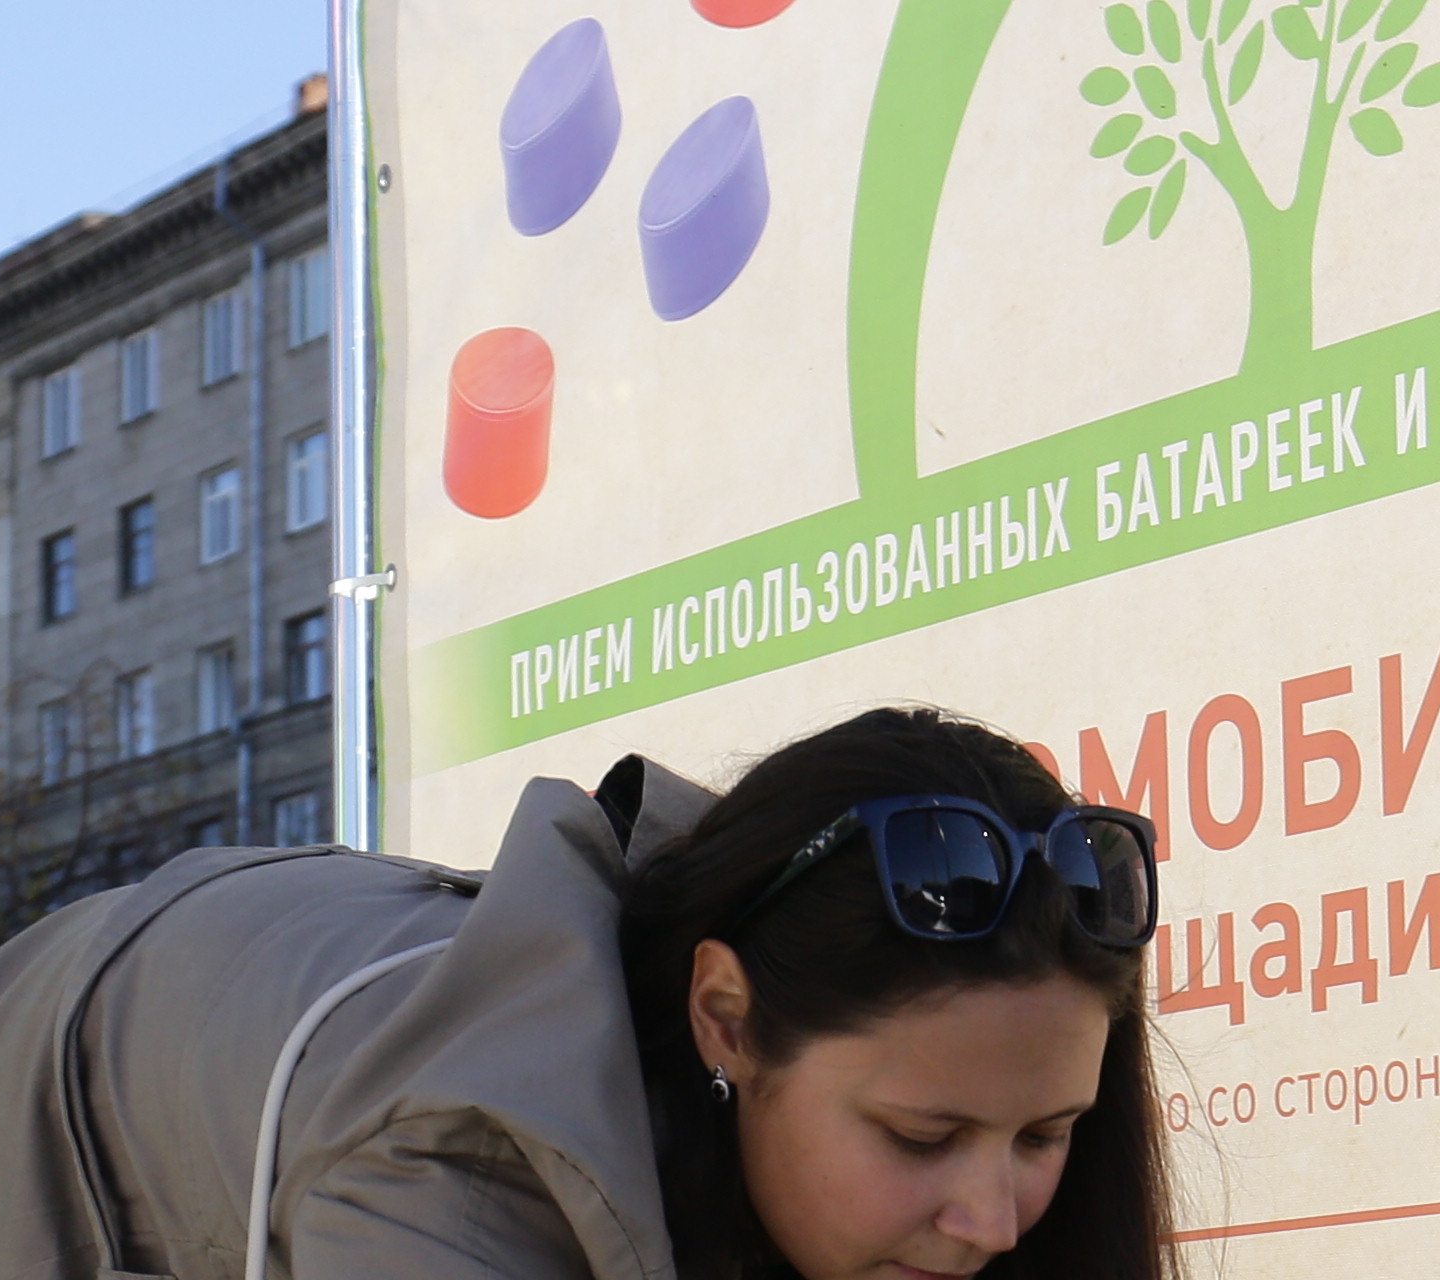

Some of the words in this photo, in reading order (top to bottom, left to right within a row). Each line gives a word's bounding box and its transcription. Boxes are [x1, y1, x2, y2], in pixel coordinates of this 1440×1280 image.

[510, 614, 632, 718] ПРИЕМ
[651, 476, 1072, 675] ИСПОЛЬЗОВАННЫХ
[1096, 386, 1366, 541] БАТАРЕЕК
[1394, 366, 1429, 451] И
[1207, 1083, 1256, 1127] со
